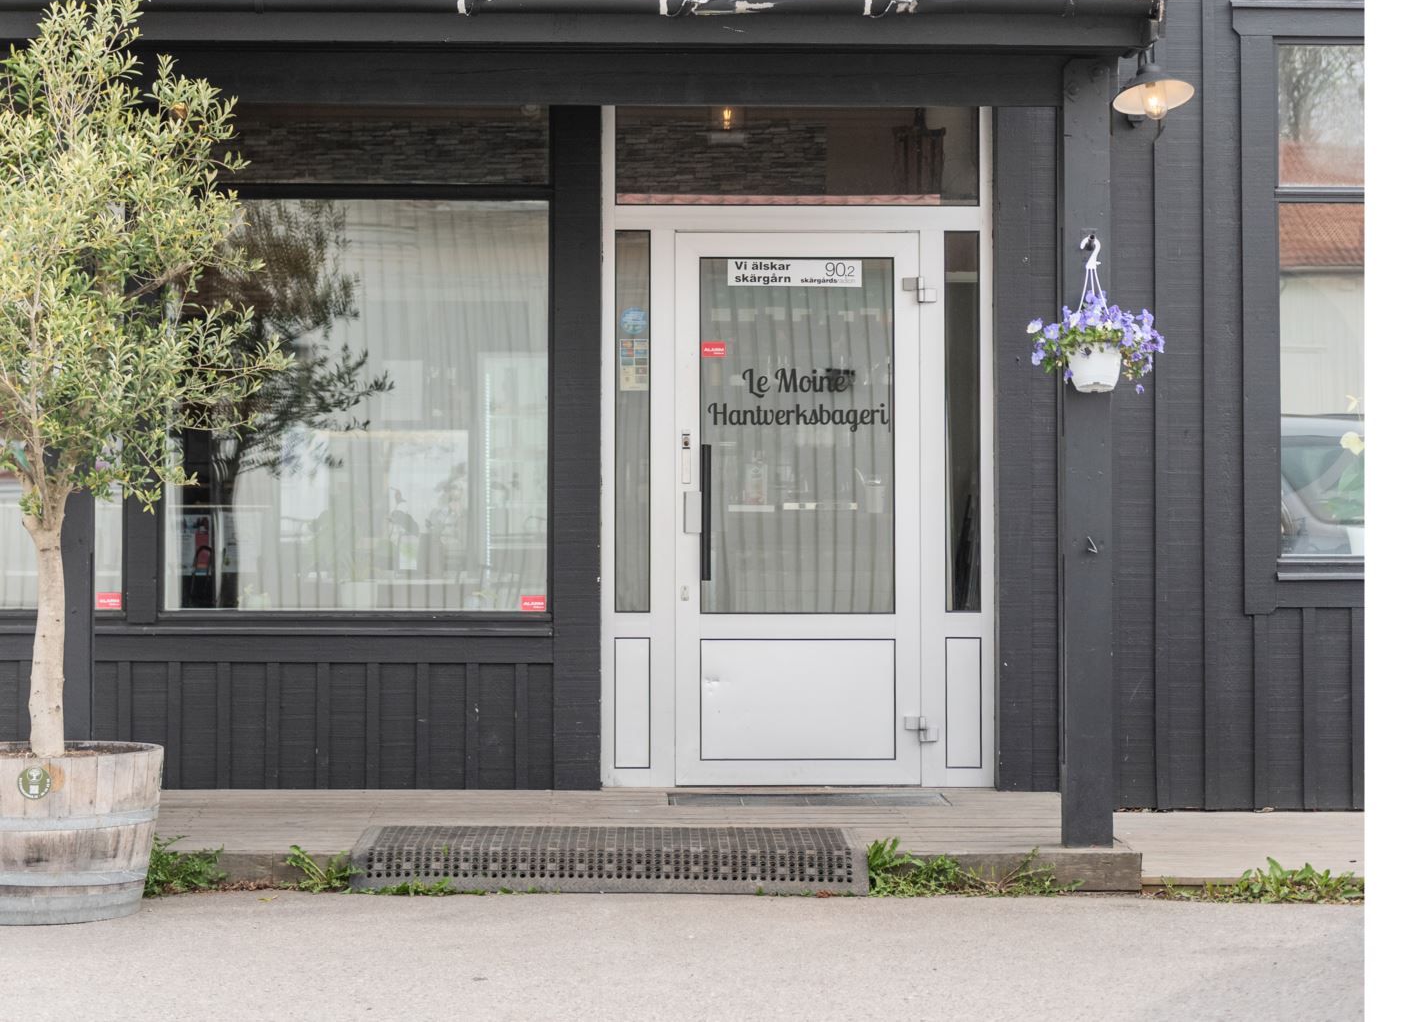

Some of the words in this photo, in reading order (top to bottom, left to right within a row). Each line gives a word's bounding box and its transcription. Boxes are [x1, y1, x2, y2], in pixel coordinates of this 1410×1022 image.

[734, 261, 748, 271] Vi
[752, 261, 791, 271] älskar
[825, 261, 855, 277] 90.2
[735, 273, 792, 285] skärgårn
[742, 368, 771, 398] Le
[774, 367, 850, 393] Moine
[707, 402, 890, 433] Hantverksbageri
